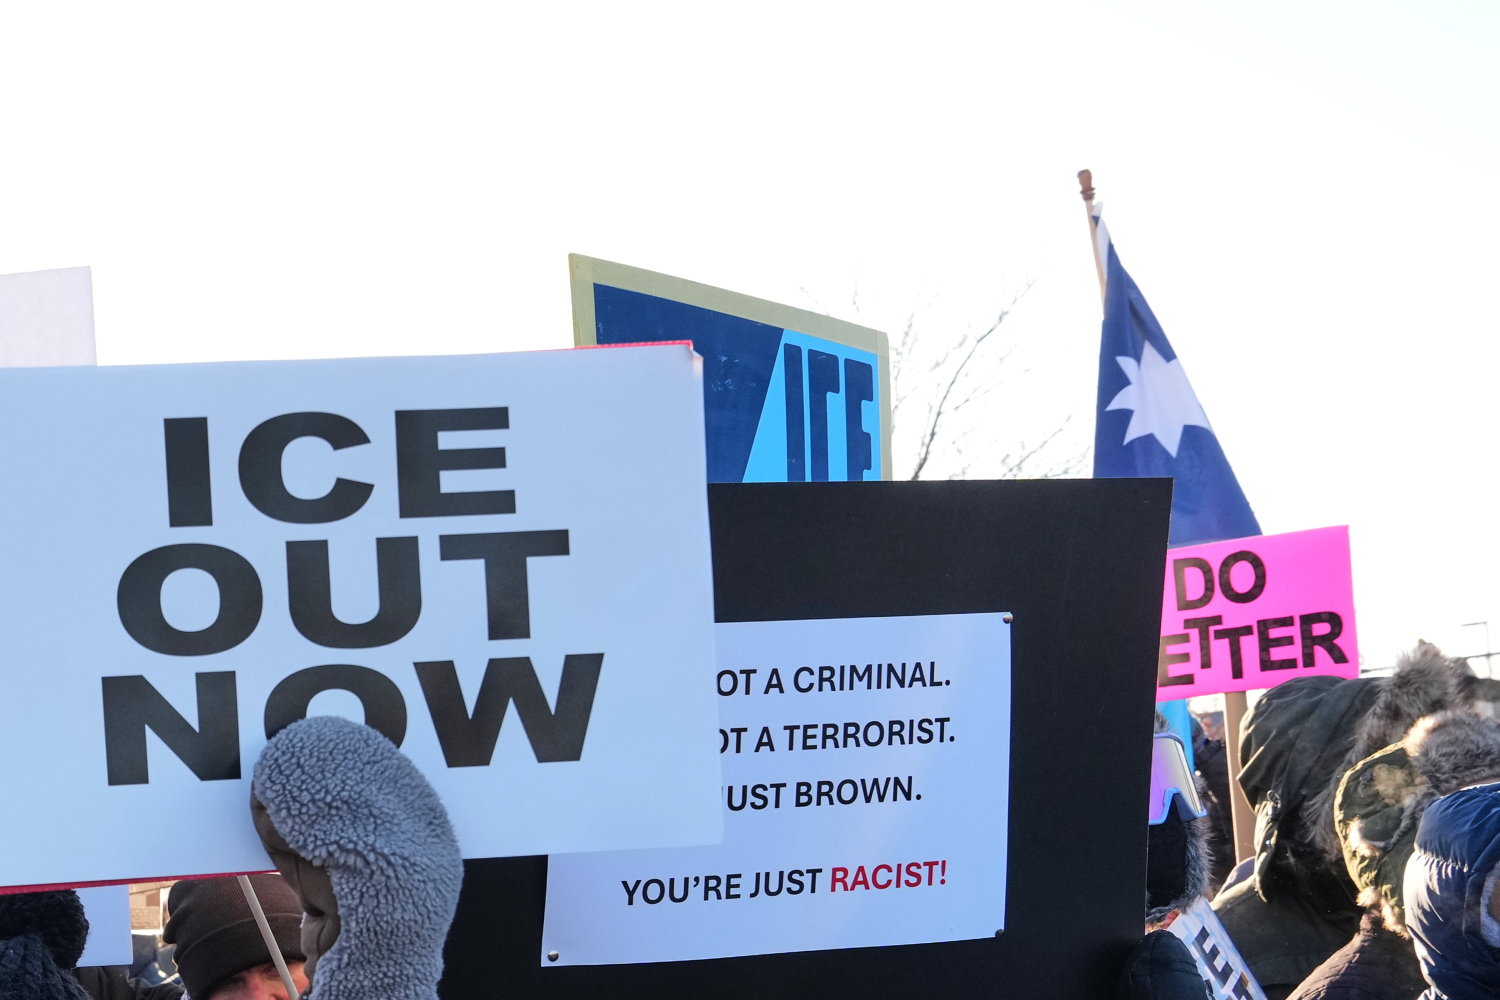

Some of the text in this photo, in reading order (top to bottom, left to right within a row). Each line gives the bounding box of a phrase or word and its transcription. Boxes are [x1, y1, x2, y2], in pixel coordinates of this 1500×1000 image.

[163, 406, 517, 528] ICE
[116, 529, 571, 656] OUT
[1172, 550, 1267, 611] DO
[764, 668, 785, 695] A
[793, 661, 951, 694] CRIMINAL.
[101, 653, 605, 786] NOW
[754, 726, 775, 753] A
[783, 717, 956, 751] TERRORIST.
[721, 775, 923, 812] UST BROWN.
[621, 860, 947, 906] YOU'RE JUST RACIST!
